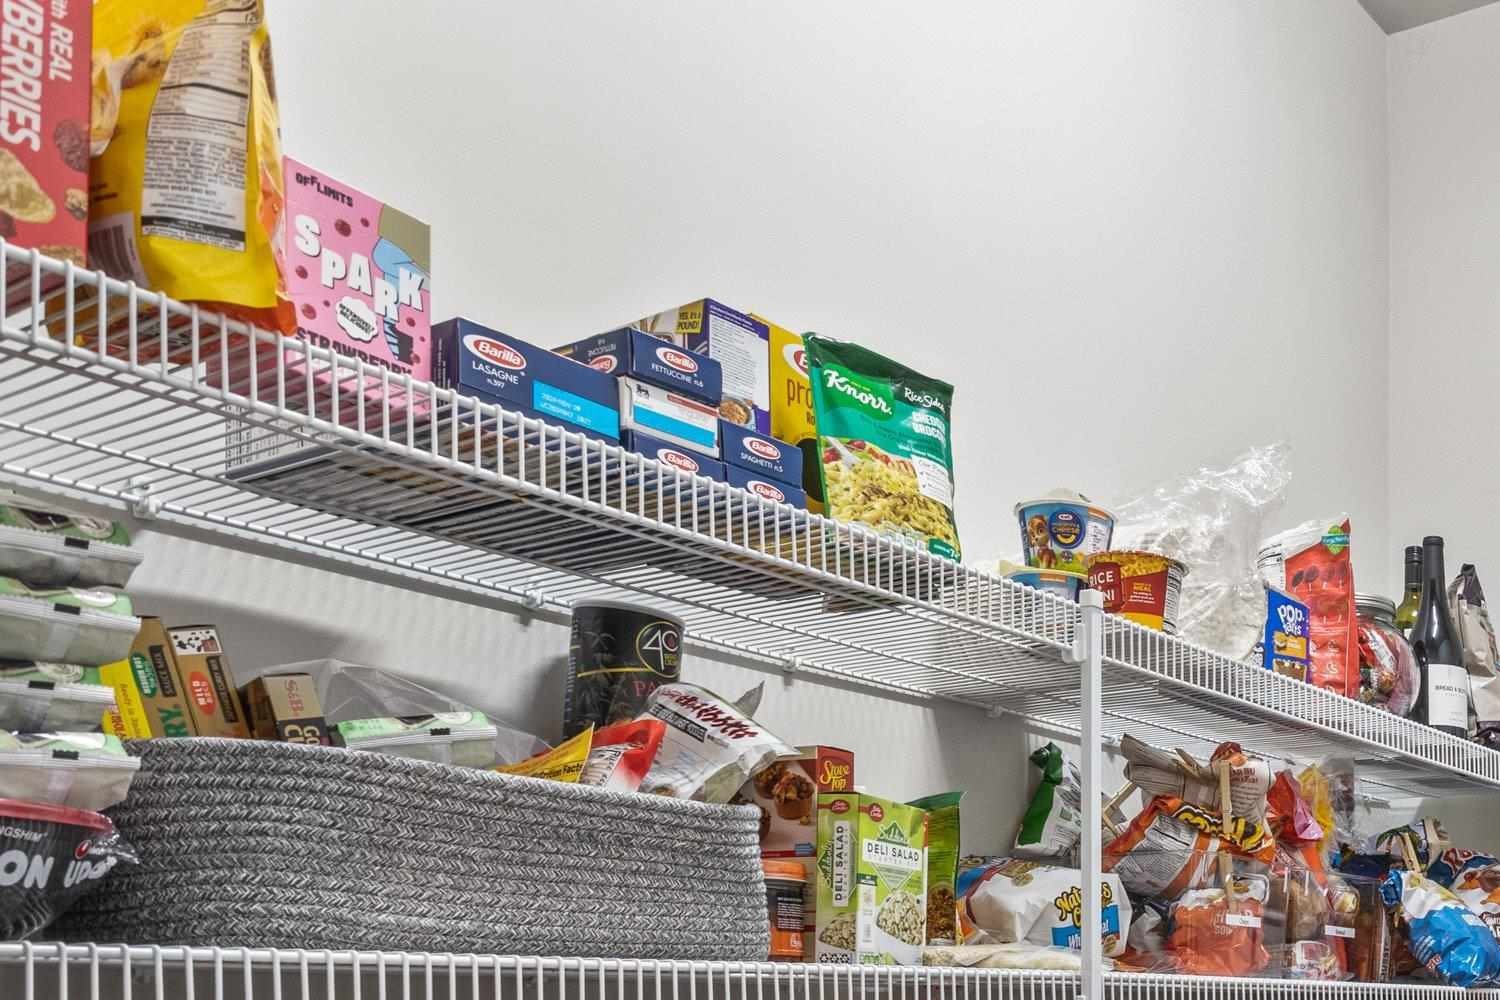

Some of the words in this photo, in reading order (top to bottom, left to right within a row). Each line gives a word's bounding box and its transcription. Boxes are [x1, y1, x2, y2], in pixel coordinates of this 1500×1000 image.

[49, 22, 73, 81] REAL
[0, 0, 44, 152] BERRIES
[294, 214, 424, 322] SPARK
[478, 341, 522, 365] Barilla
[666, 352, 696, 370] Barilla
[472, 360, 519, 385] LASAGNE
[651, 363, 692, 384] FETTUCCINE
[787, 378, 812, 408] pro
[823, 368, 892, 414] Knorr
[904, 387, 923, 403] Rice
[740, 453, 773, 469] SPAGHETTI
[750, 442, 779, 458] Barilla
[667, 453, 696, 472] Barilla
[755, 484, 783, 501] Barilla
[1089, 570, 1114, 587] RICE
[642, 629, 679, 671] 4C
[820, 760, 850, 784] Stove
[834, 825, 844, 869] SALAD
[866, 842, 889, 857] DELI
[892, 845, 920, 863] SALAD
[834, 873, 844, 902] DELI
